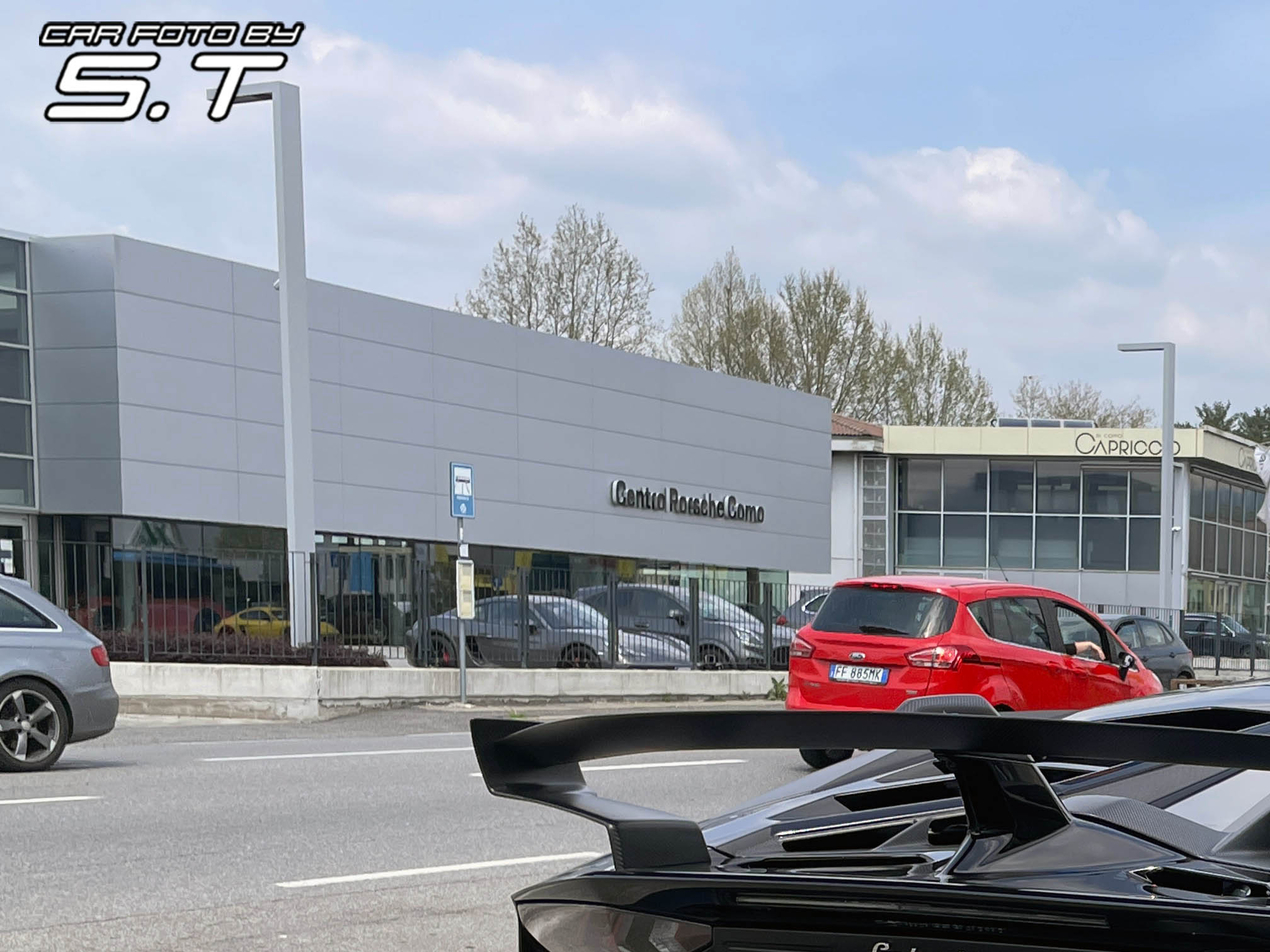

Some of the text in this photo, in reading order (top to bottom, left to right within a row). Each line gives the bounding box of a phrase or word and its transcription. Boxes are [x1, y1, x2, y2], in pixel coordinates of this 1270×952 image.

[1076, 432, 1180, 455] CAPRICCO
[611, 479, 666, 511] Centro
[724, 495, 765, 523] Como
